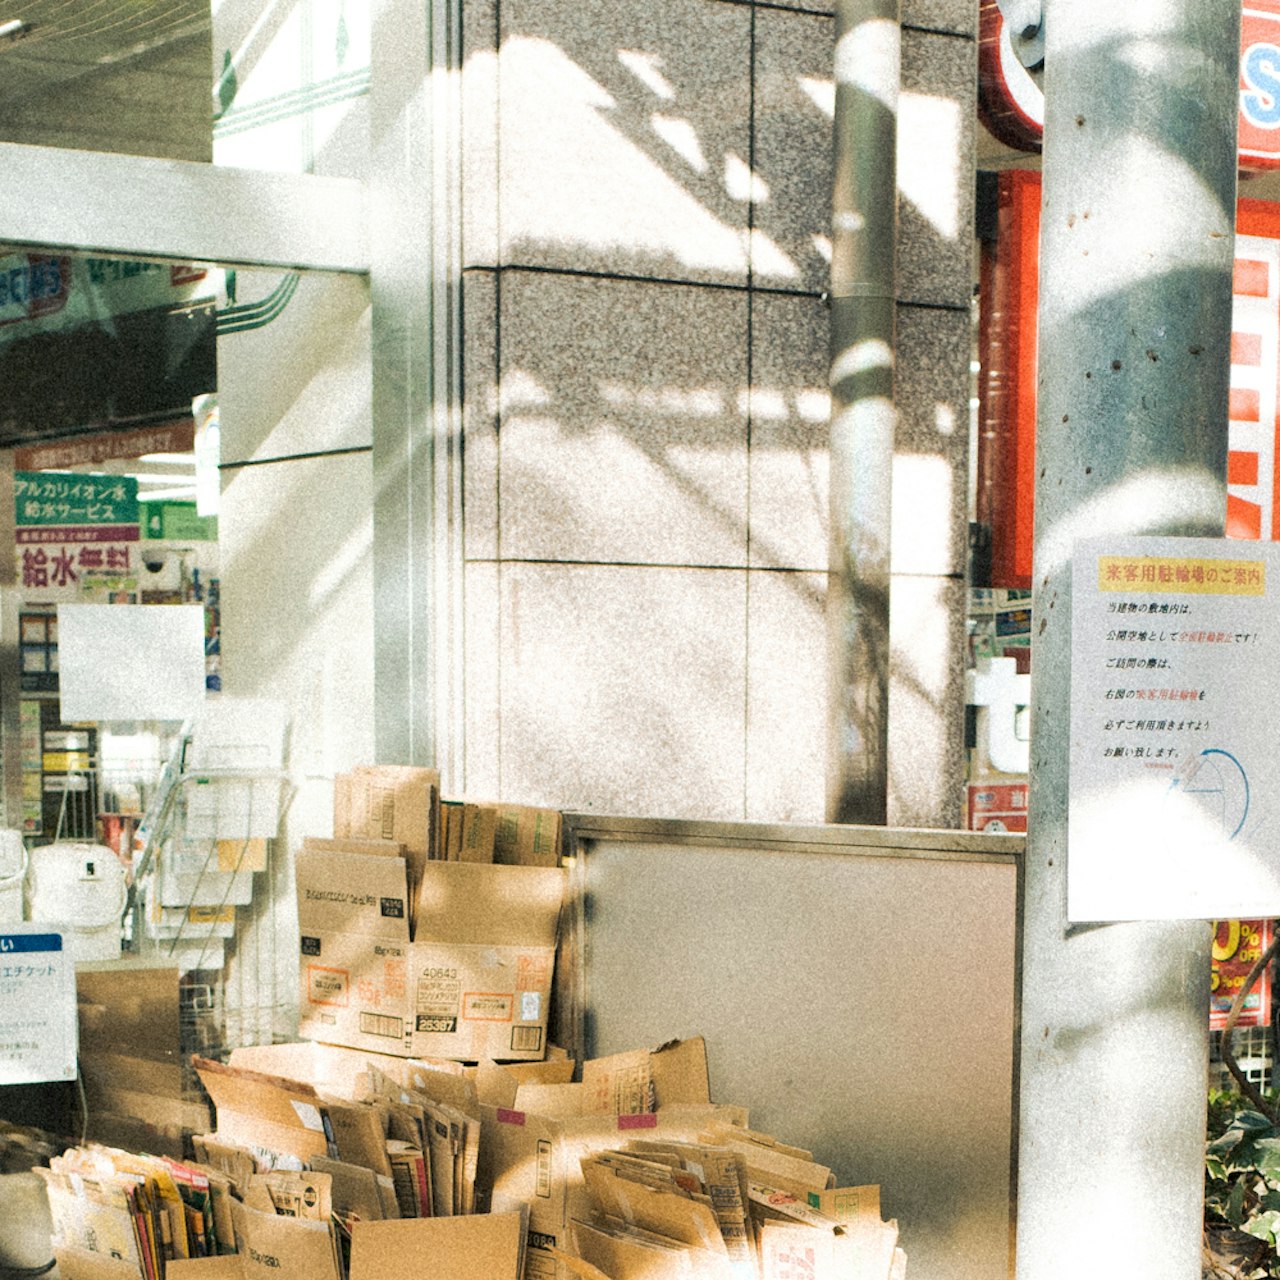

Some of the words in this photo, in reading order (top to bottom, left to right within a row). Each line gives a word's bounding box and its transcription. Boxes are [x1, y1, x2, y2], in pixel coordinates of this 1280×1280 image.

[15, 480, 127, 501] アルカリイオン水
[25, 501, 116, 520] 給水サービス
[1105, 563, 1261, 586] 来客用駐輪場のご案内
[422, 967, 458, 980] 40643
